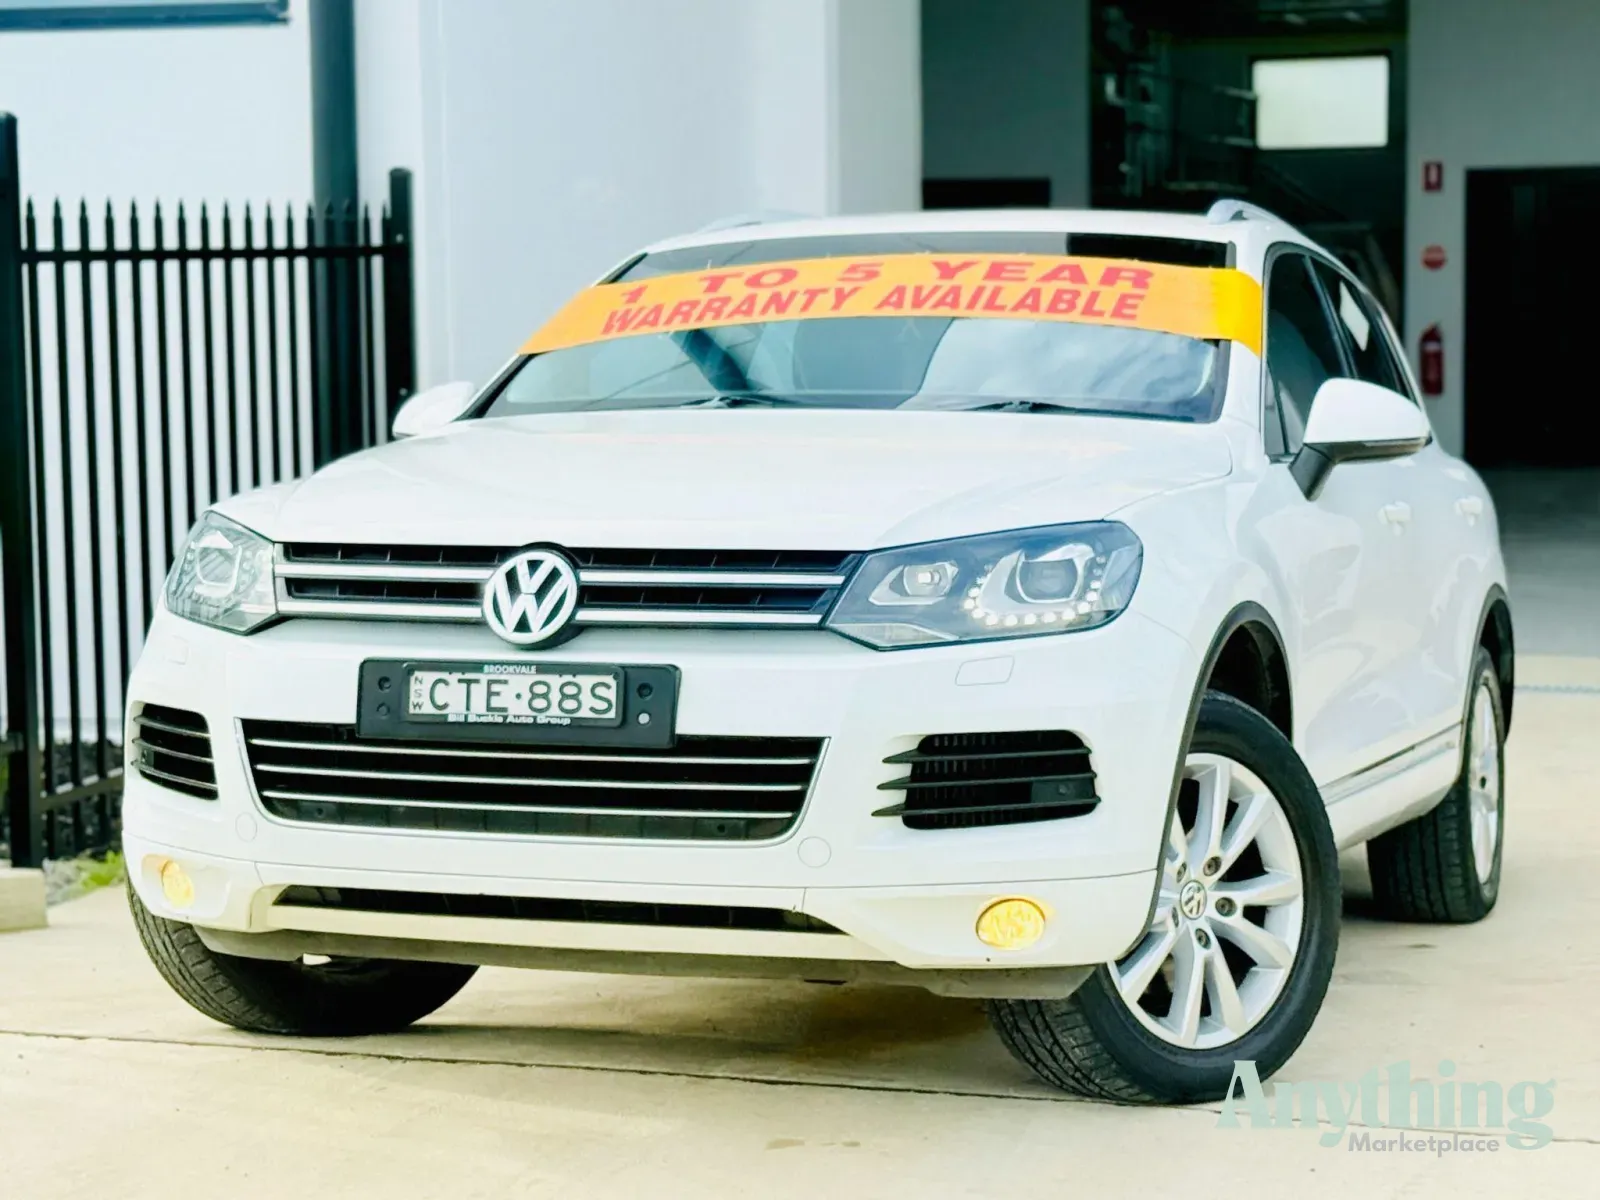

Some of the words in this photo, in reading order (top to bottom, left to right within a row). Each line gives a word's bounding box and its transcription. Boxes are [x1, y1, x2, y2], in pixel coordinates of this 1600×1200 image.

[621, 285, 648, 304] 1
[699, 268, 799, 293] TO
[837, 262, 884, 282] 5
[931, 260, 1154, 289] YEAR
[601, 286, 863, 335] WARRANTY
[874, 284, 1146, 320] AVAILABLE
[483, 665, 537, 674] BROOKVALE
[447, 713, 465, 722] Bill
[506, 715, 534, 723] Auto
[536, 715, 571, 726] Group
